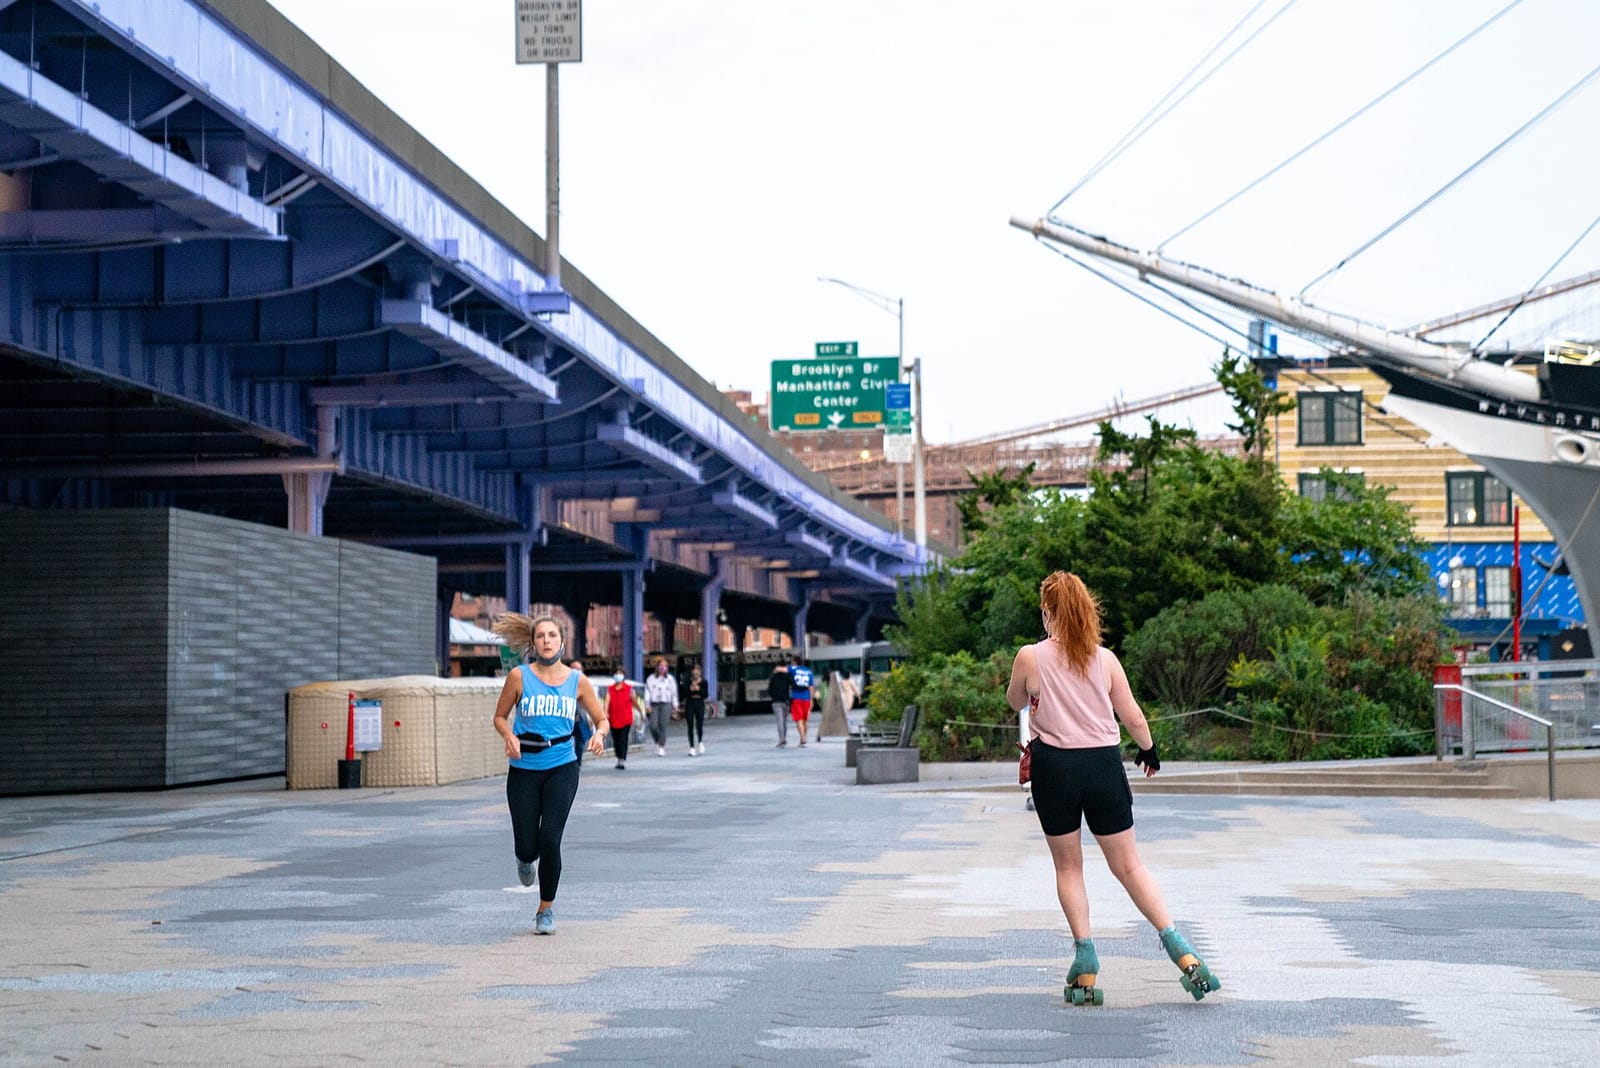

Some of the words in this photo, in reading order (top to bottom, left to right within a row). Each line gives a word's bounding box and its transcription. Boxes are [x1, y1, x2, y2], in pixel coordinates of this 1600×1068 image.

[518, 2, 561, 11] BROOKLYN
[520, 14, 549, 23] WEIGHT
[555, 13, 576, 22] LIMIT
[543, 25, 565, 34] TONS
[524, 37, 535, 46] NO
[541, 36, 573, 45] TRUCKS
[526, 49, 538, 57] OR
[543, 48, 570, 57] BUSES
[791, 362, 854, 379] Brooklyn
[863, 361, 879, 375] Br
[776, 379, 851, 393] Manhattan
[813, 394, 859, 408] Center
